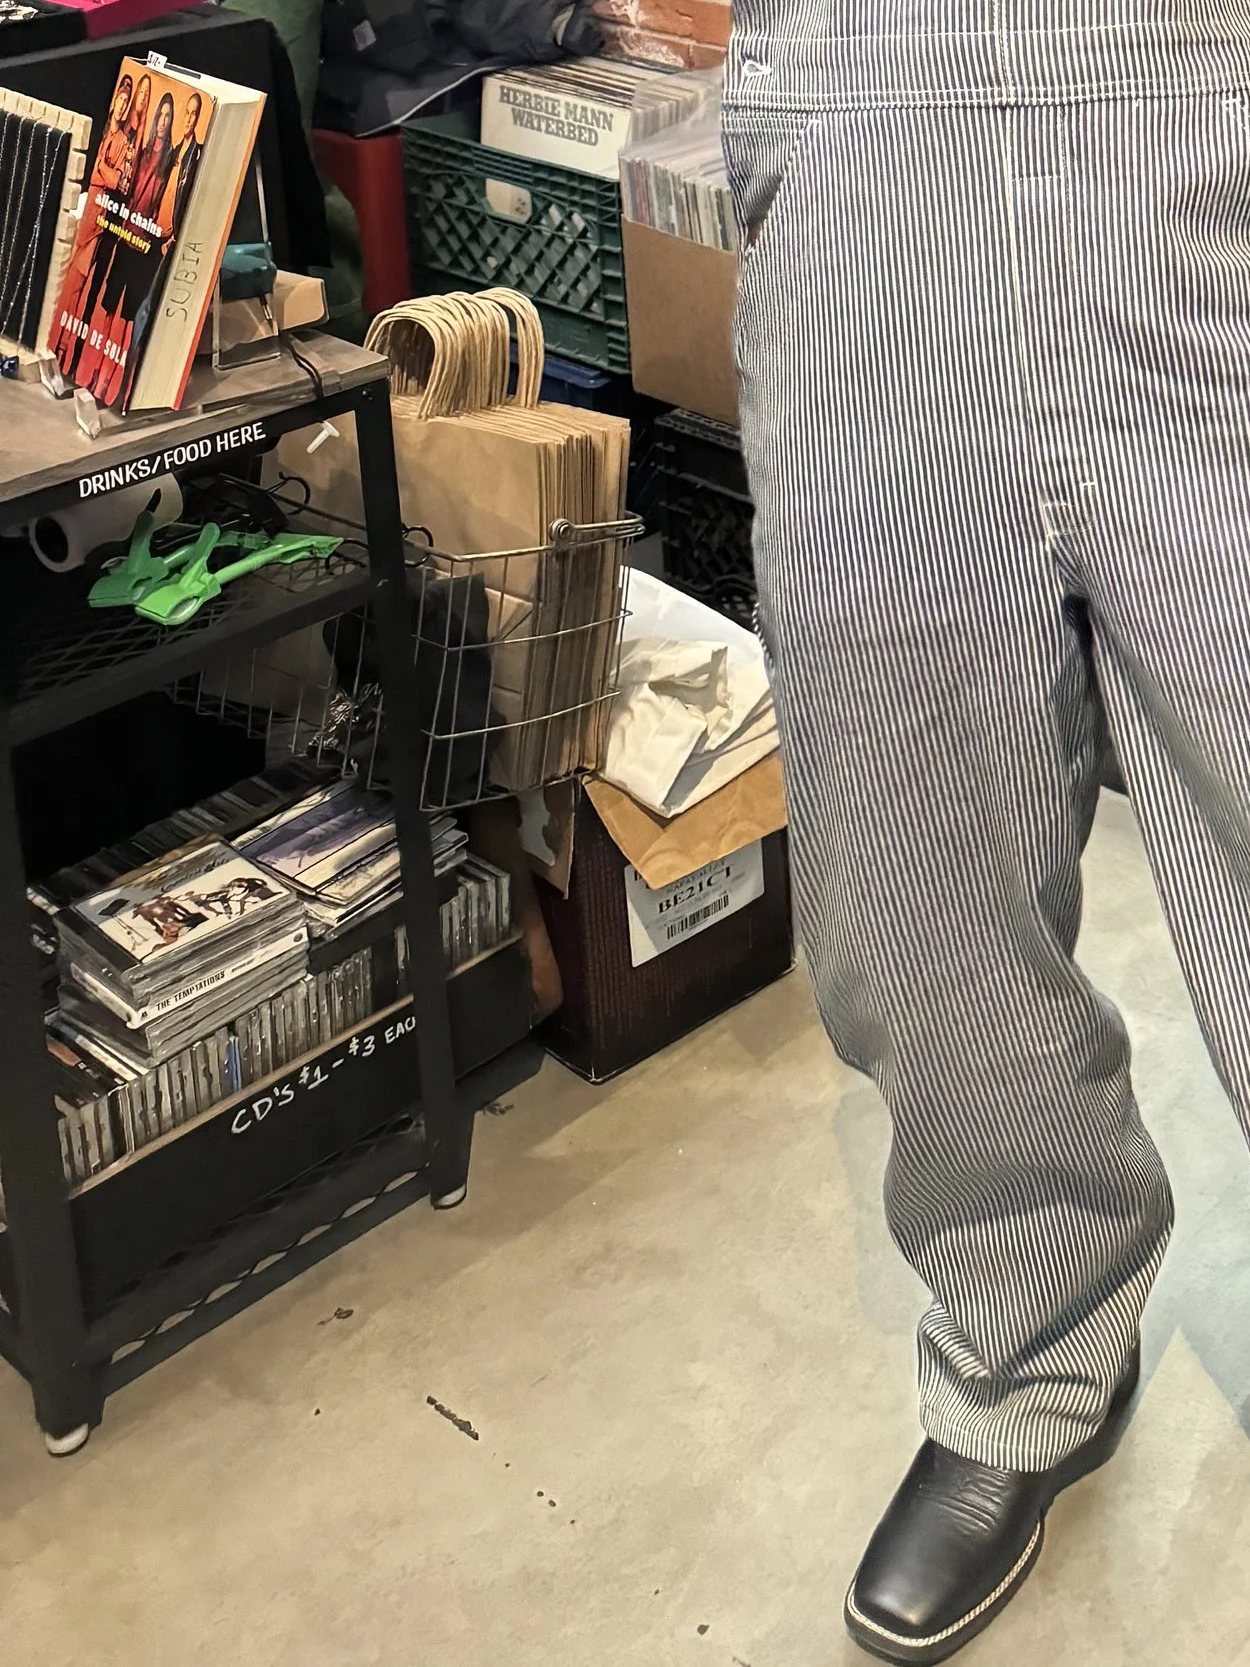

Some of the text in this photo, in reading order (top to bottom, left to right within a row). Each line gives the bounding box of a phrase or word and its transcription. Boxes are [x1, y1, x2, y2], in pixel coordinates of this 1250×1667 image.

[499, 86, 614, 132] HERBIE MANN
[511, 107, 599, 147] WATERBED
[95, 193, 163, 238] alice in chains
[96, 214, 152, 255] the untold story
[166, 241, 203, 322] SUBIA
[60, 311, 128, 367] DAVID DE SOLA
[78, 422, 266, 498] DRINKS/FOOD HERE
[156, 971, 226, 1012] THE TEMPTATIONS
[348, 1035, 376, 1057] $3
